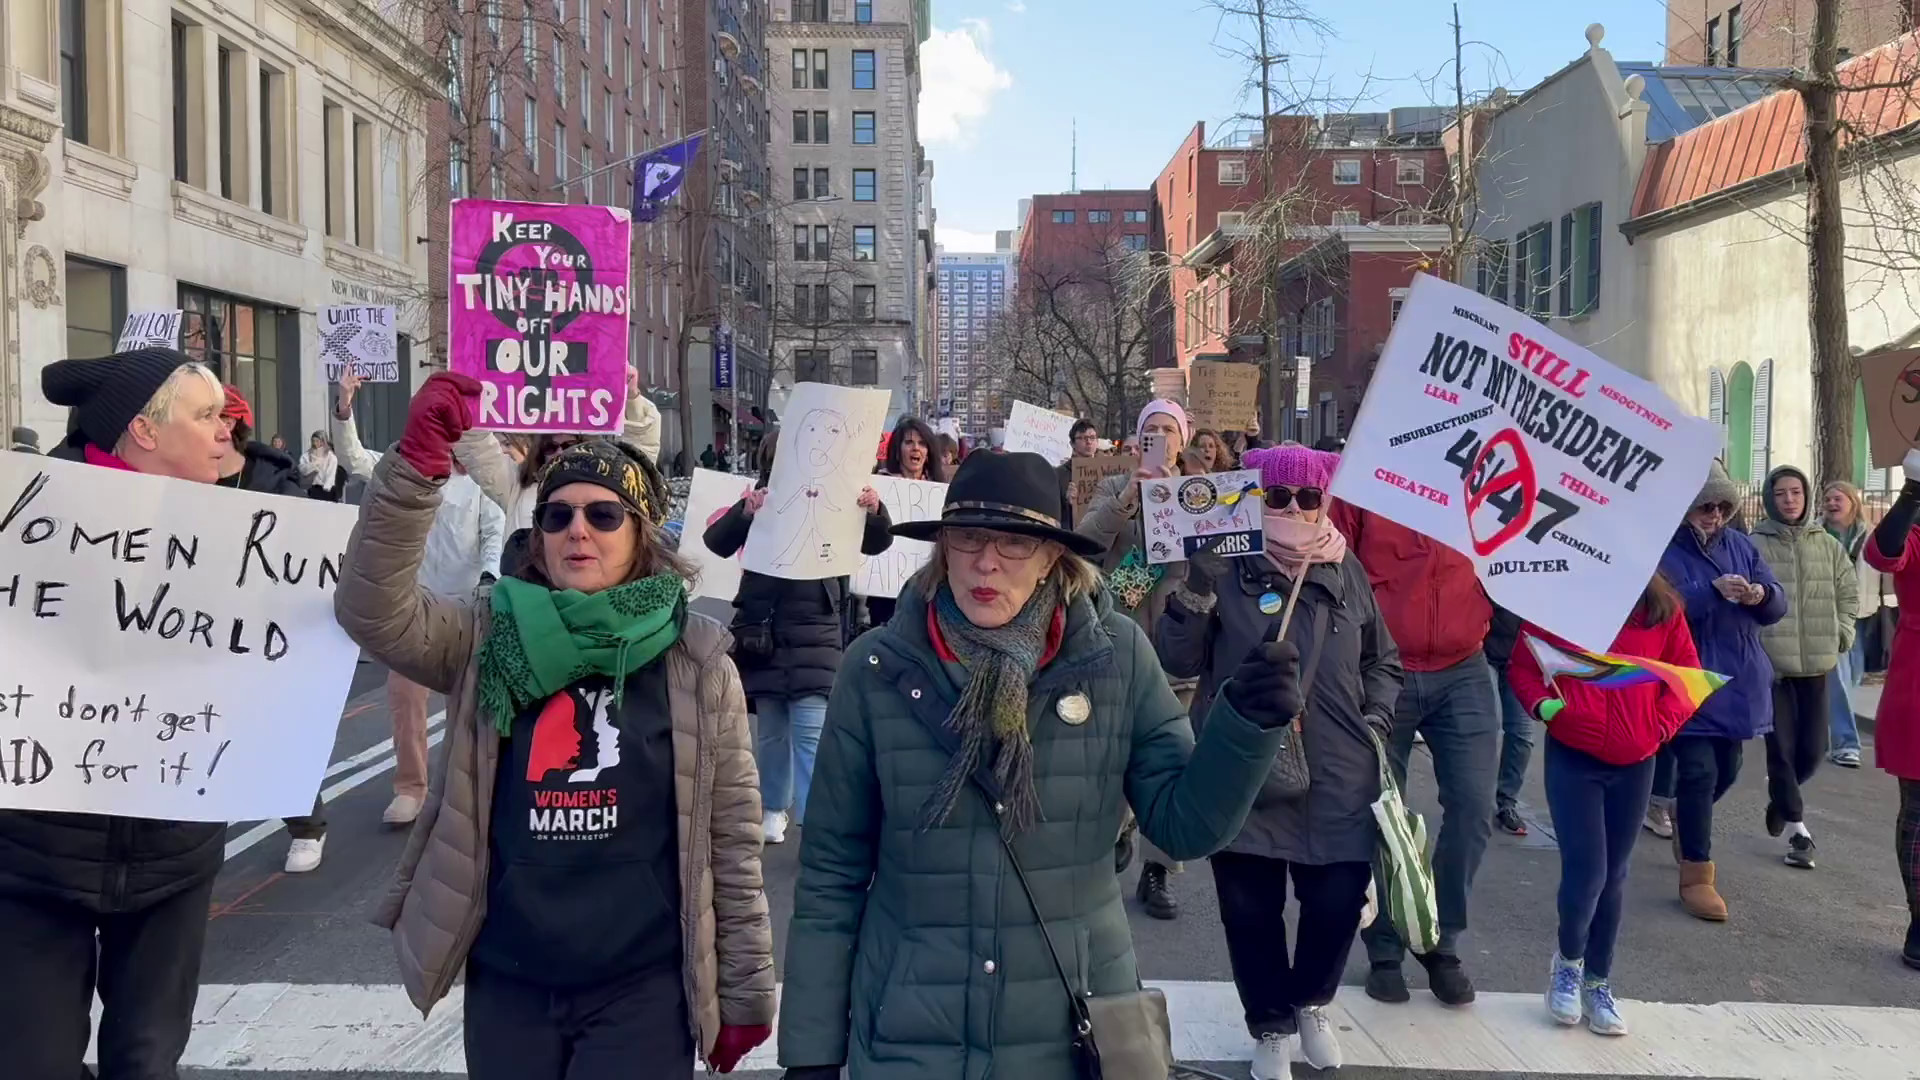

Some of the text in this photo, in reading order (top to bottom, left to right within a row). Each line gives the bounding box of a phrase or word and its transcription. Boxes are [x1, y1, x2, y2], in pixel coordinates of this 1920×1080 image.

[492, 211, 553, 243] KEEP
[533, 245, 587, 269] YOUR
[331, 279, 348, 296] NEW
[350, 284, 369, 302] YORK
[456, 273, 626, 315] TINY HANDS
[145, 312, 180, 341] LOVE
[327, 307, 387, 327] UNITE THE
[516, 317, 551, 335] OFF
[1452, 305, 1500, 335] MISCREANT
[495, 338, 570, 377] OUR
[1508, 331, 1592, 398] STILL
[479, 380, 613, 427] RIGHTS
[1424, 383, 1460, 406] LIAR
[1389, 404, 1494, 447] INSURRECTIONIST
[1419, 331, 1664, 493] NOT MY PRESIDENT
[1374, 466, 1449, 507] CHEATER
[1559, 471, 1610, 506] THIEF
[1551, 530, 1611, 564] CRIMINAL
[1487, 559, 1570, 577] ADULTER
[114, 577, 289, 662] WORLD
[58, 684, 149, 724] don't
[156, 702, 221, 741] get
[75, 738, 138, 785] for
[160, 739, 231, 796] it!
[535, 788, 617, 808] WOMEN'S
[529, 806, 618, 832] MARCH
